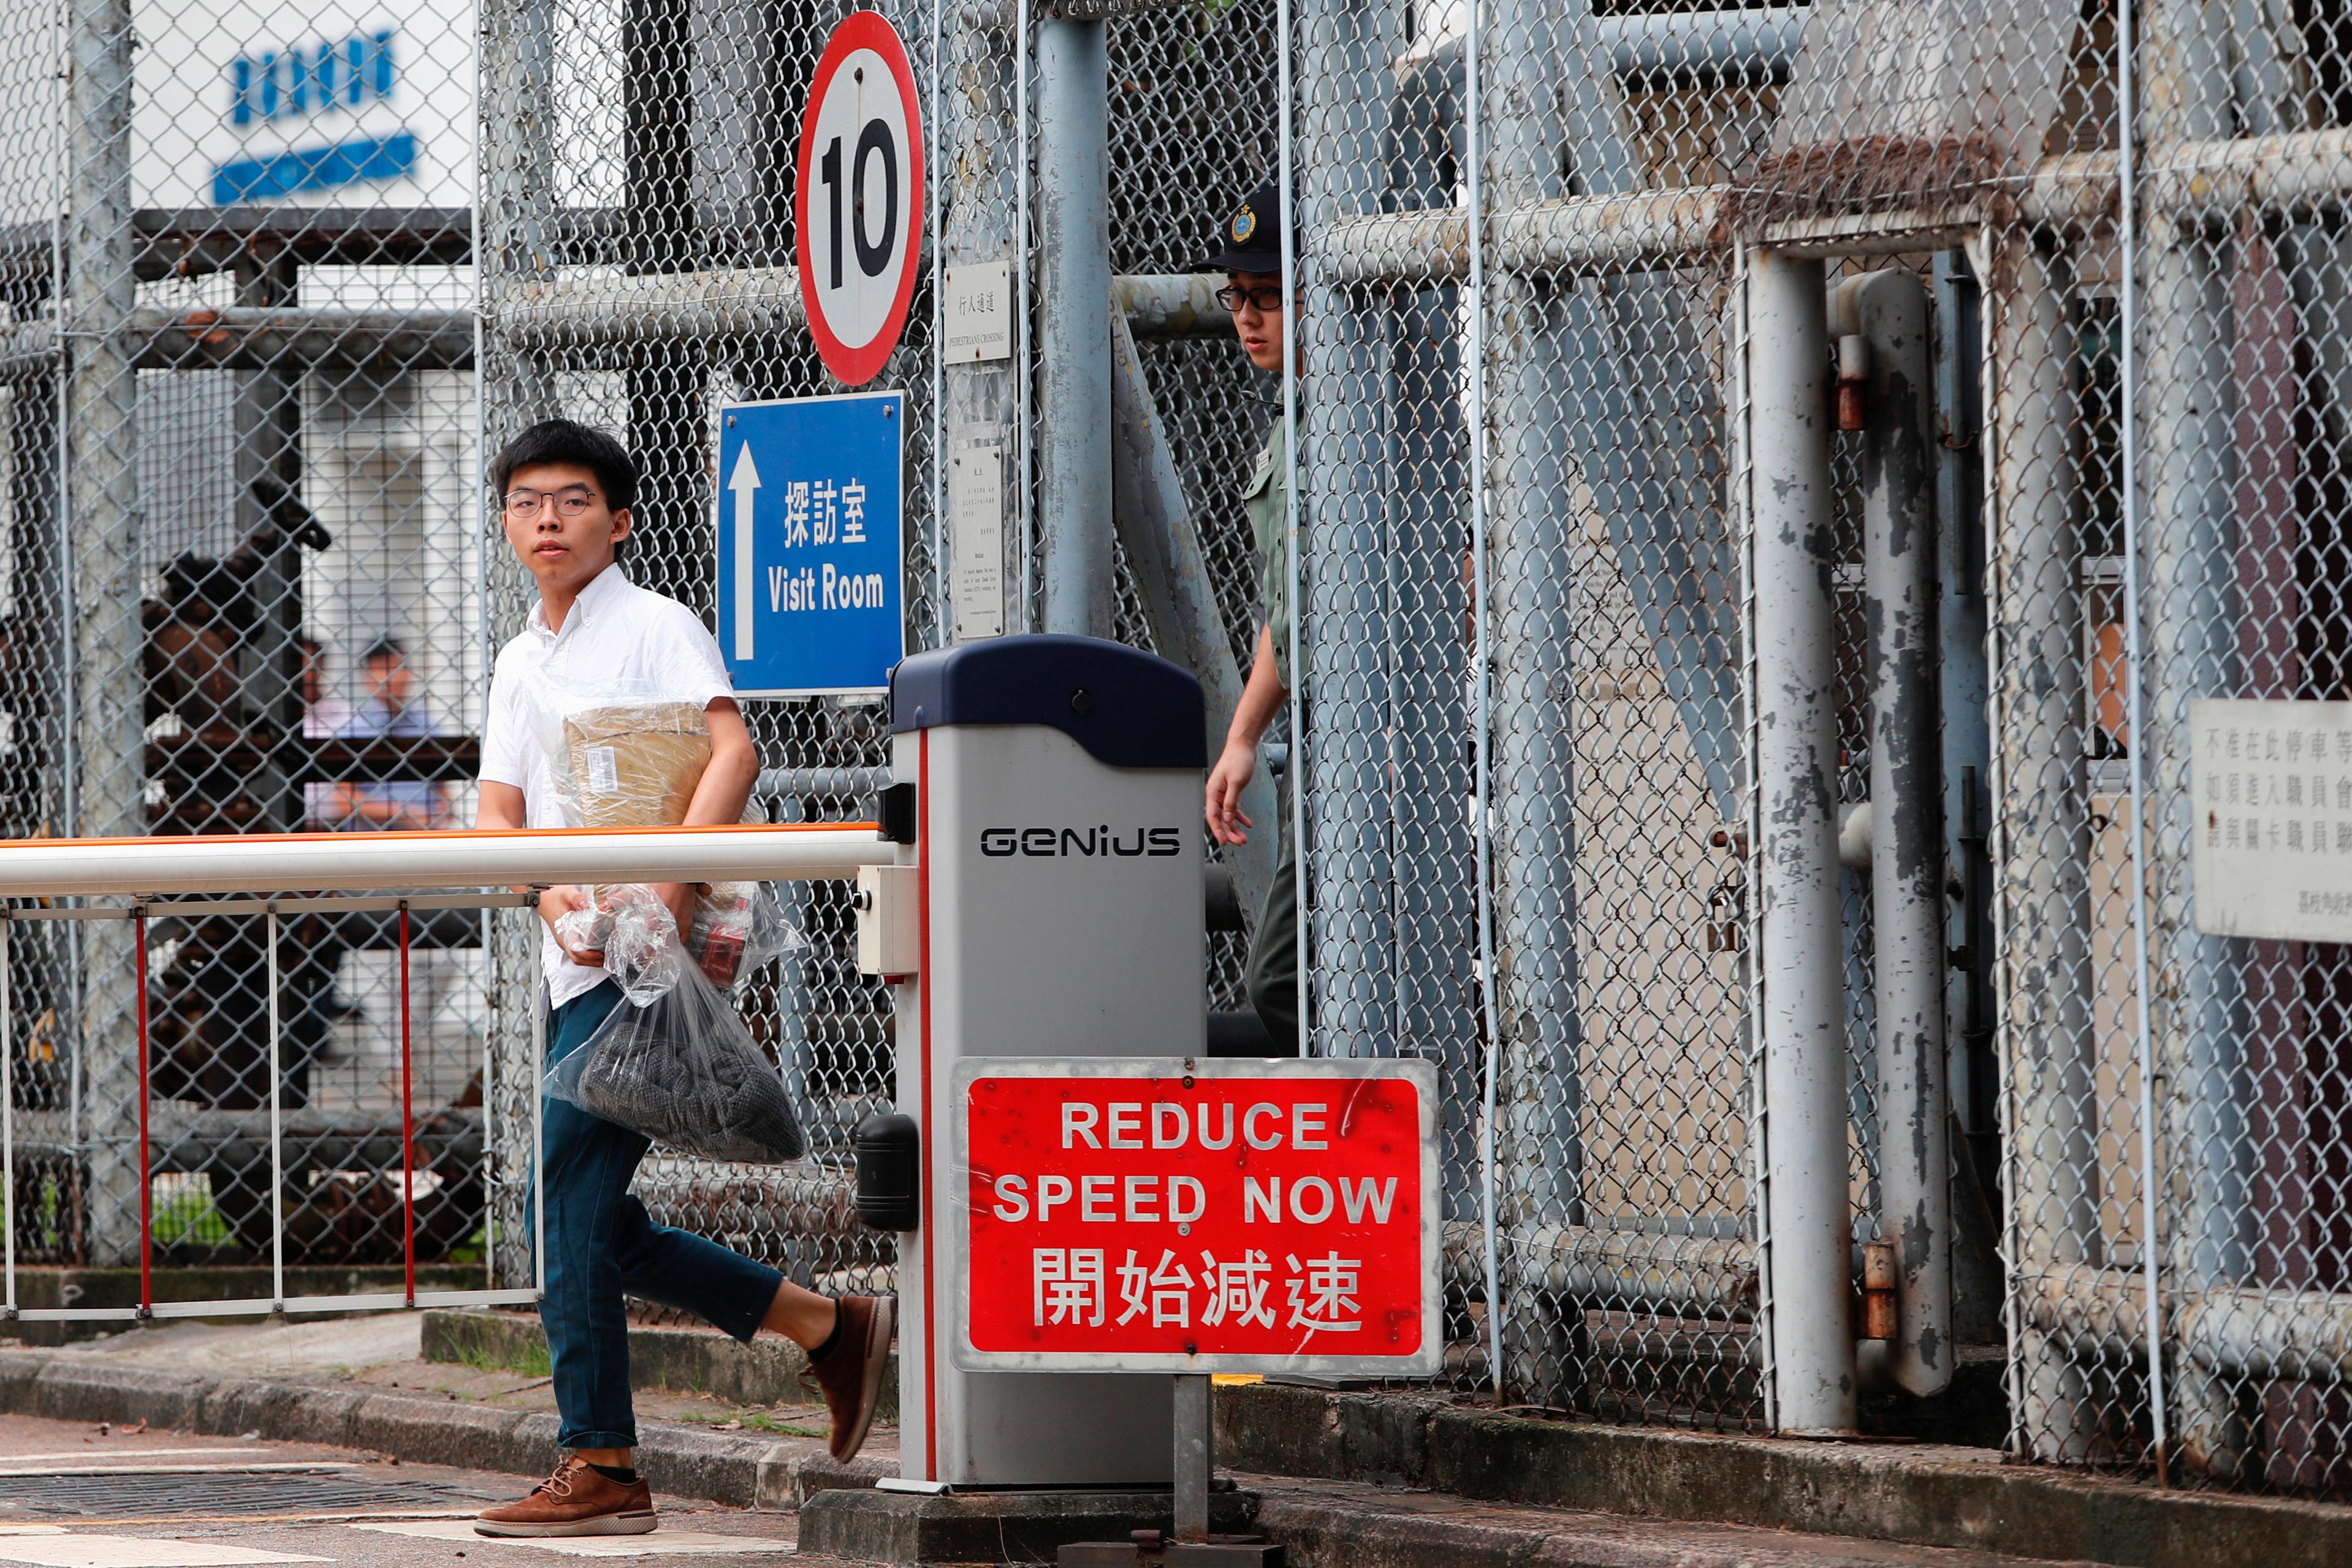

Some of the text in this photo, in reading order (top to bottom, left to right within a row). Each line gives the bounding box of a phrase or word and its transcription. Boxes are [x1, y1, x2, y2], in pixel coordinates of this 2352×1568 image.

[822, 118, 897, 289] 10
[959, 291, 994, 316] 行人通道
[950, 332, 1003, 348] PEDESTRIANS CROSSING
[784, 478, 867, 549] 探訪室
[768, 563, 883, 612] Visit Room
[1062, 1102, 1328, 1151] REDUCE
[993, 1174, 1398, 1225] SPEED NOW
[1033, 1247, 1362, 1332] 開始減速
